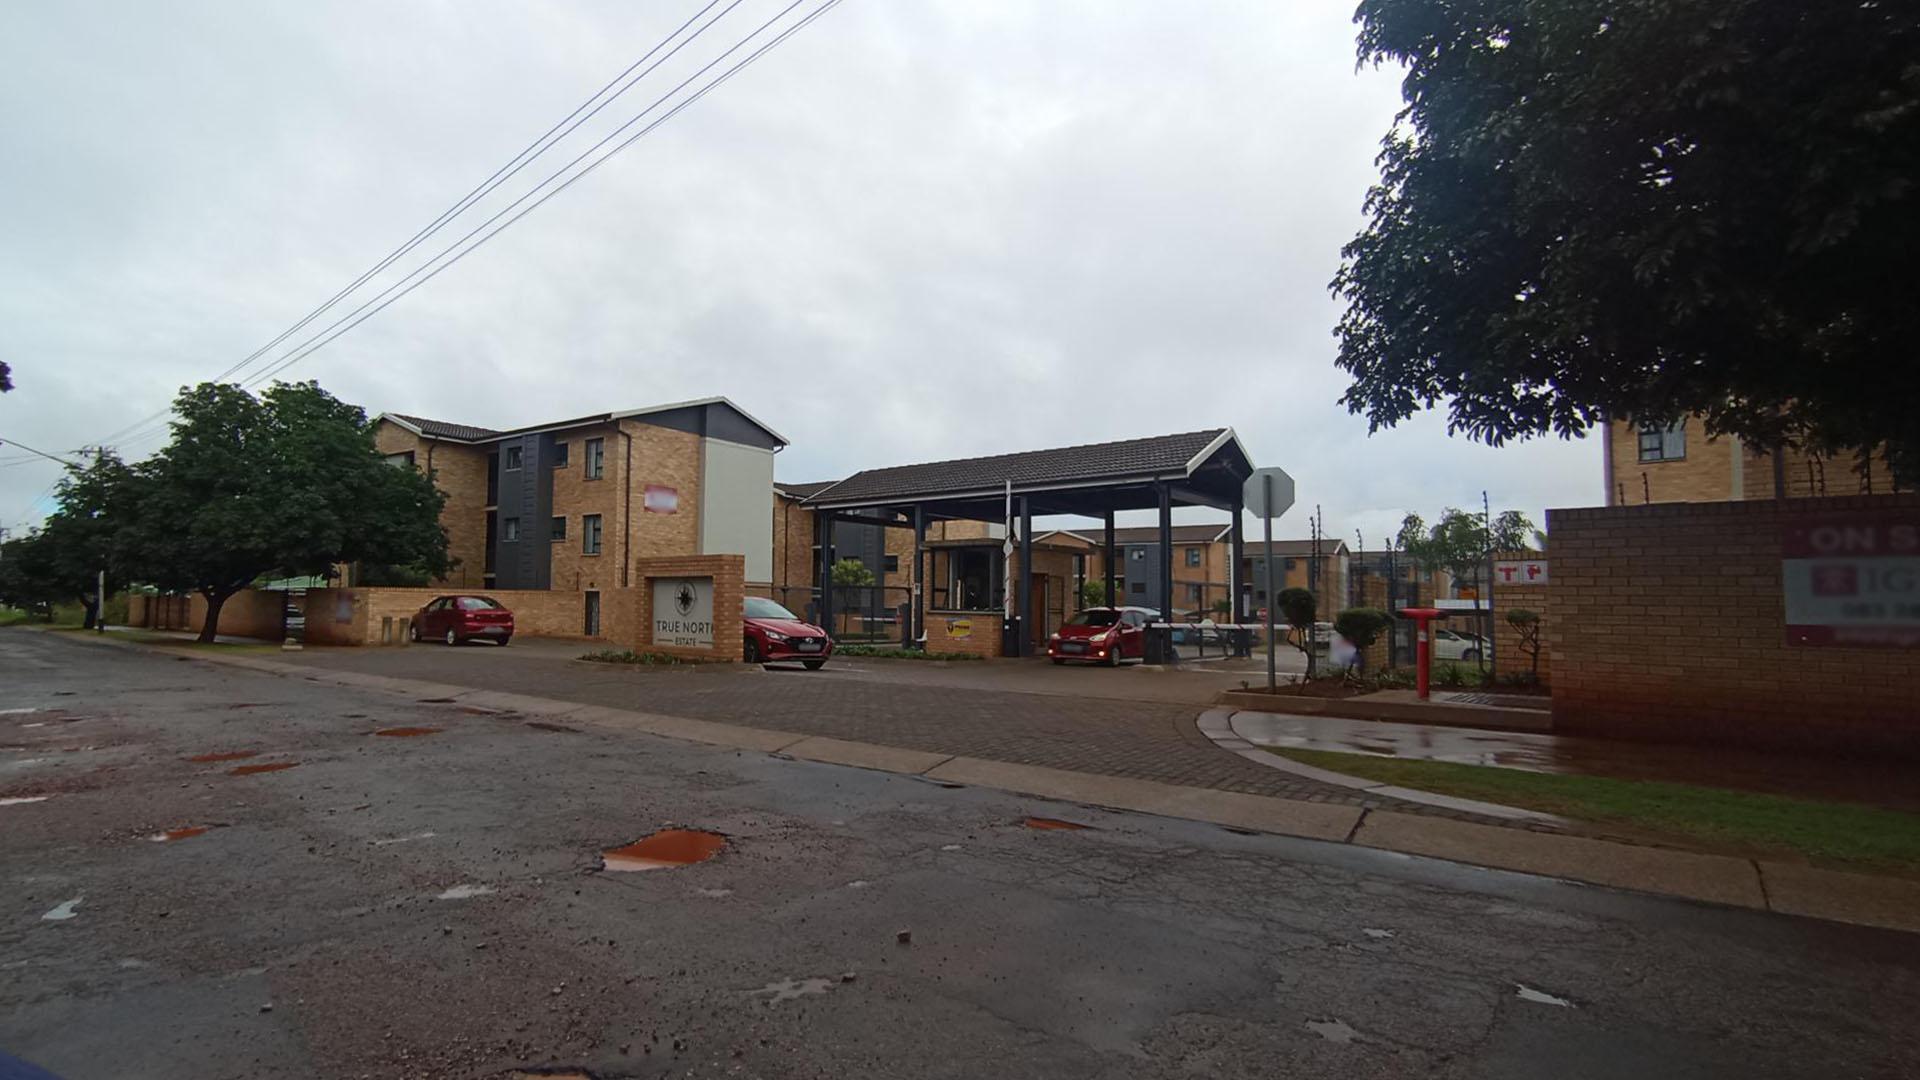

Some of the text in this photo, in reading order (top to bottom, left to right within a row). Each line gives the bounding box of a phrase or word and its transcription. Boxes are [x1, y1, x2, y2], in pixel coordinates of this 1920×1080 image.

[1810, 527, 1876, 550] ON
[656, 620, 680, 632] TRUE
[675, 636, 696, 646] ESTATE
